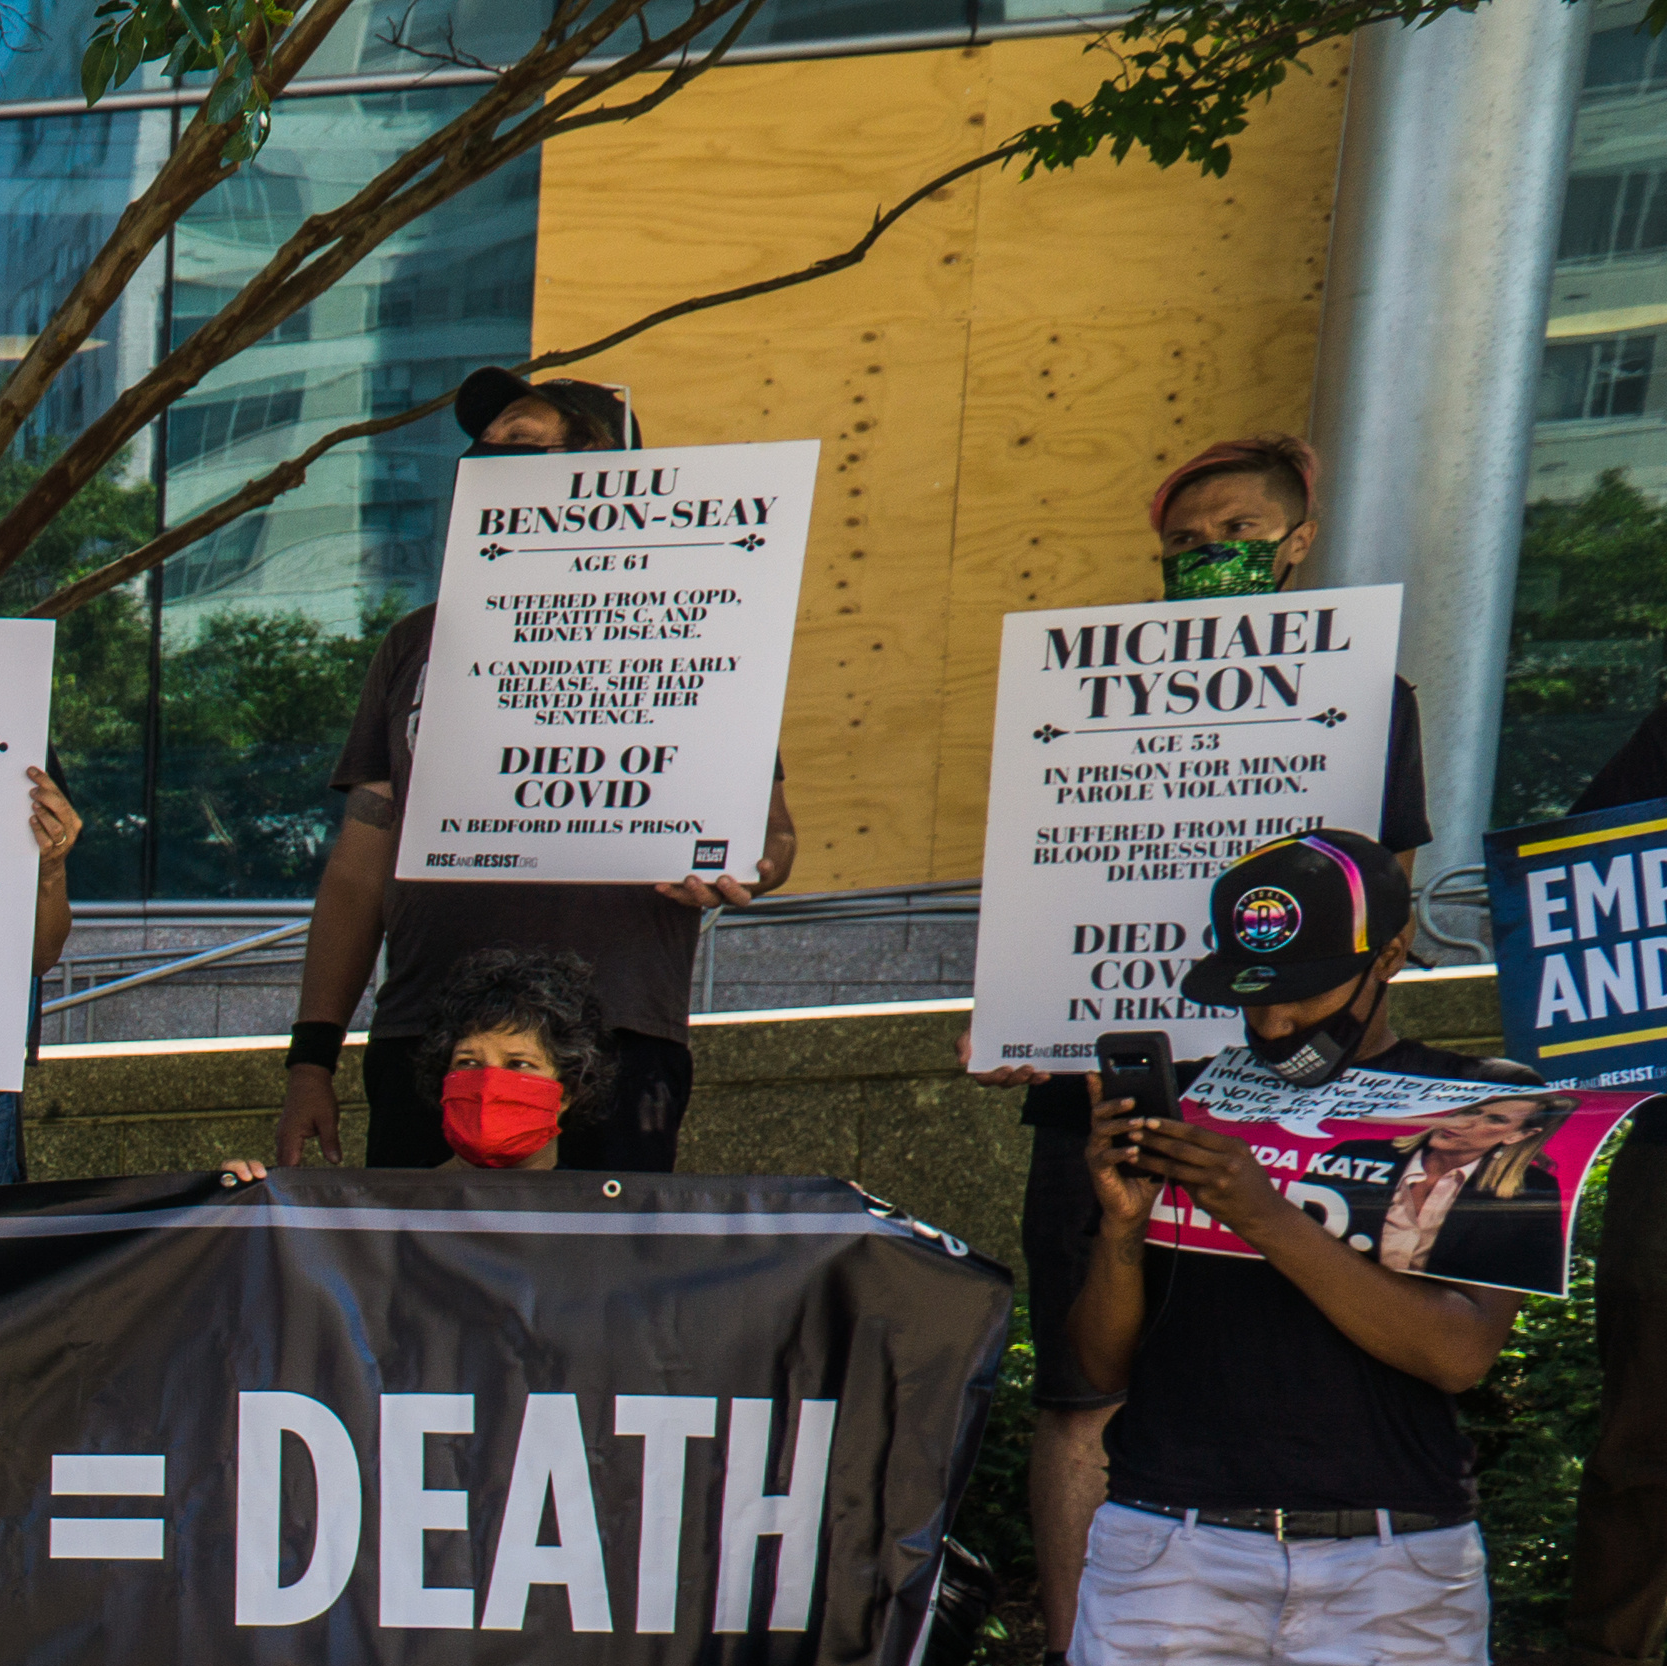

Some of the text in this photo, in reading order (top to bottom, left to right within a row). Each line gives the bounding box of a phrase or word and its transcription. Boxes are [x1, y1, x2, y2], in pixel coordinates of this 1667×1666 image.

[569, 467, 678, 499] LULU
[478, 496, 777, 535] BENSON-SEAY
[569, 554, 648, 572] AGE 61
[485, 589, 742, 610] SUFFERED FROM COPD,
[513, 624, 701, 642] KIDNEY DISEASE.
[1042, 608, 1350, 671] MICHAEL
[1080, 663, 1304, 719] TYSON
[1132, 733, 1220, 755] AGE 53
[499, 745, 678, 774] DIED OF
[1044, 754, 1326, 785] IN PRISON FOR MINOR
[514, 780, 651, 808] COVID
[1057, 776, 1307, 804] PAROLE VIOLATION.
[440, 818, 702, 833] IN BEDFORD HILLS PRISON
[1036, 816, 1324, 843] SUFFERED FROM HIGH
[1034, 839, 1255, 864] BLOOD PRESSURE
[1072, 922, 1186, 954] DIED
[1068, 999, 1240, 1021] IN RIKERS
[1304, 1152, 1393, 1184] KATZ
[49, 1454, 165, 1560] =
[234, 1390, 836, 1634] DEATH
